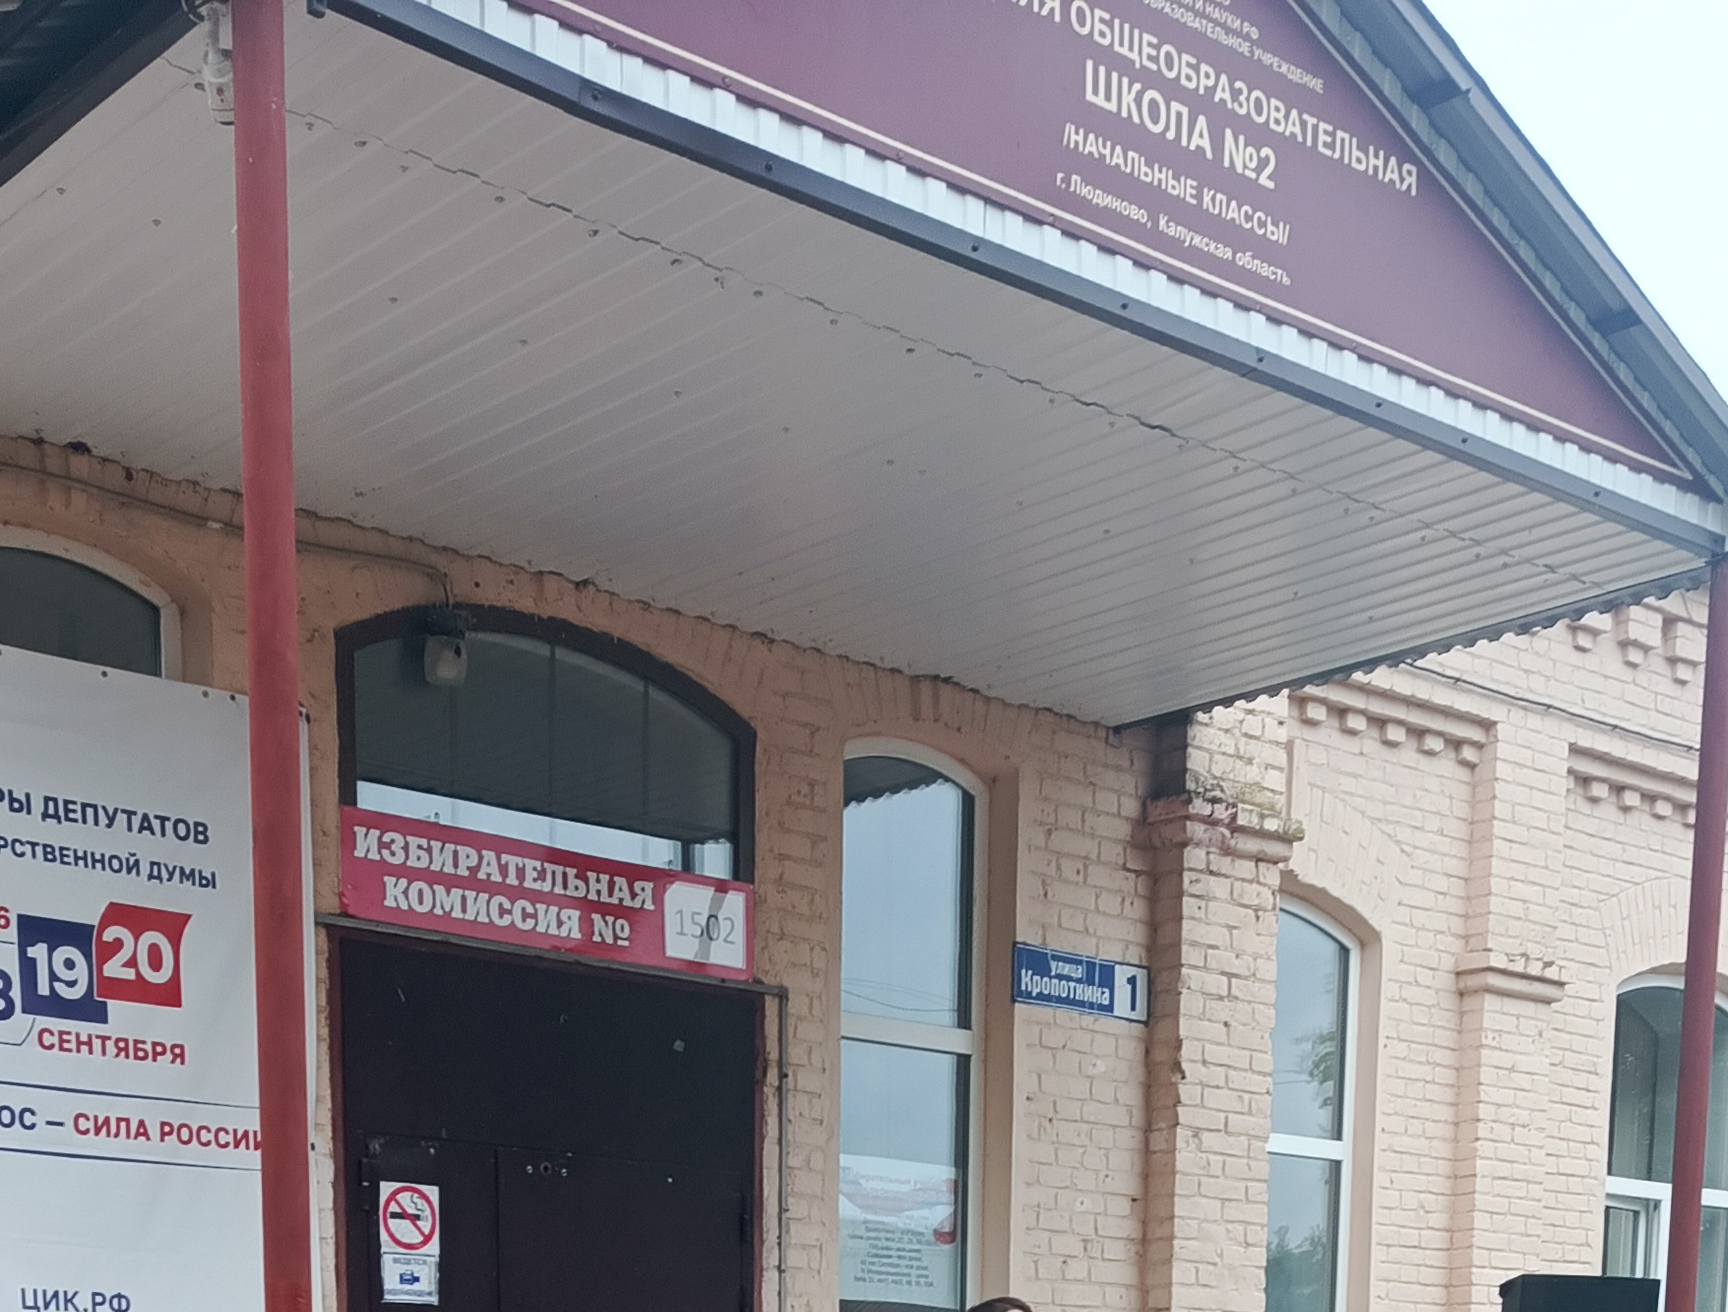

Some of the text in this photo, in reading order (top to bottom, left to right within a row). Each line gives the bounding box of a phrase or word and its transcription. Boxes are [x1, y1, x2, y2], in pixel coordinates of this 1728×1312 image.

[1143, 0, 1324, 94] БРАЗОВАТЕЛЬНОЕ УЧРЕЖДЕНИЕ
[1205, 1, 1241, 32] НАУКИ
[1243, 21, 1259, 39] РФ
[1070, 0, 1418, 196] ОБЩЕОБРАЗОВАТЕЛЬНАЯ
[1085, 58, 1276, 190] ШКОЛА №2
[1063, 122, 1290, 246] /НАЧАЛЬНЫЕ КЛАССЫ/
[1056, 172, 1291, 286] г. Людиново, Калужская область
[41, 795, 210, 845] ДЕПУТАТОВ
[147, 862, 217, 890] ДУМЫ
[353, 826, 655, 910] ИЗБИРАТЕЛЬНАЯ
[383, 876, 736, 946] КОМИССИЯ № 1502
[26, 942, 89, 999] 19
[102, 926, 174, 984] 20
[1021, 968, 1138, 1012] Кропоткина 1
[1051, 959, 1083, 979] улица
[37, 1028, 186, 1065] СЕНТЯБРЯ
[73, 1112, 151, 1142] СИЛА
